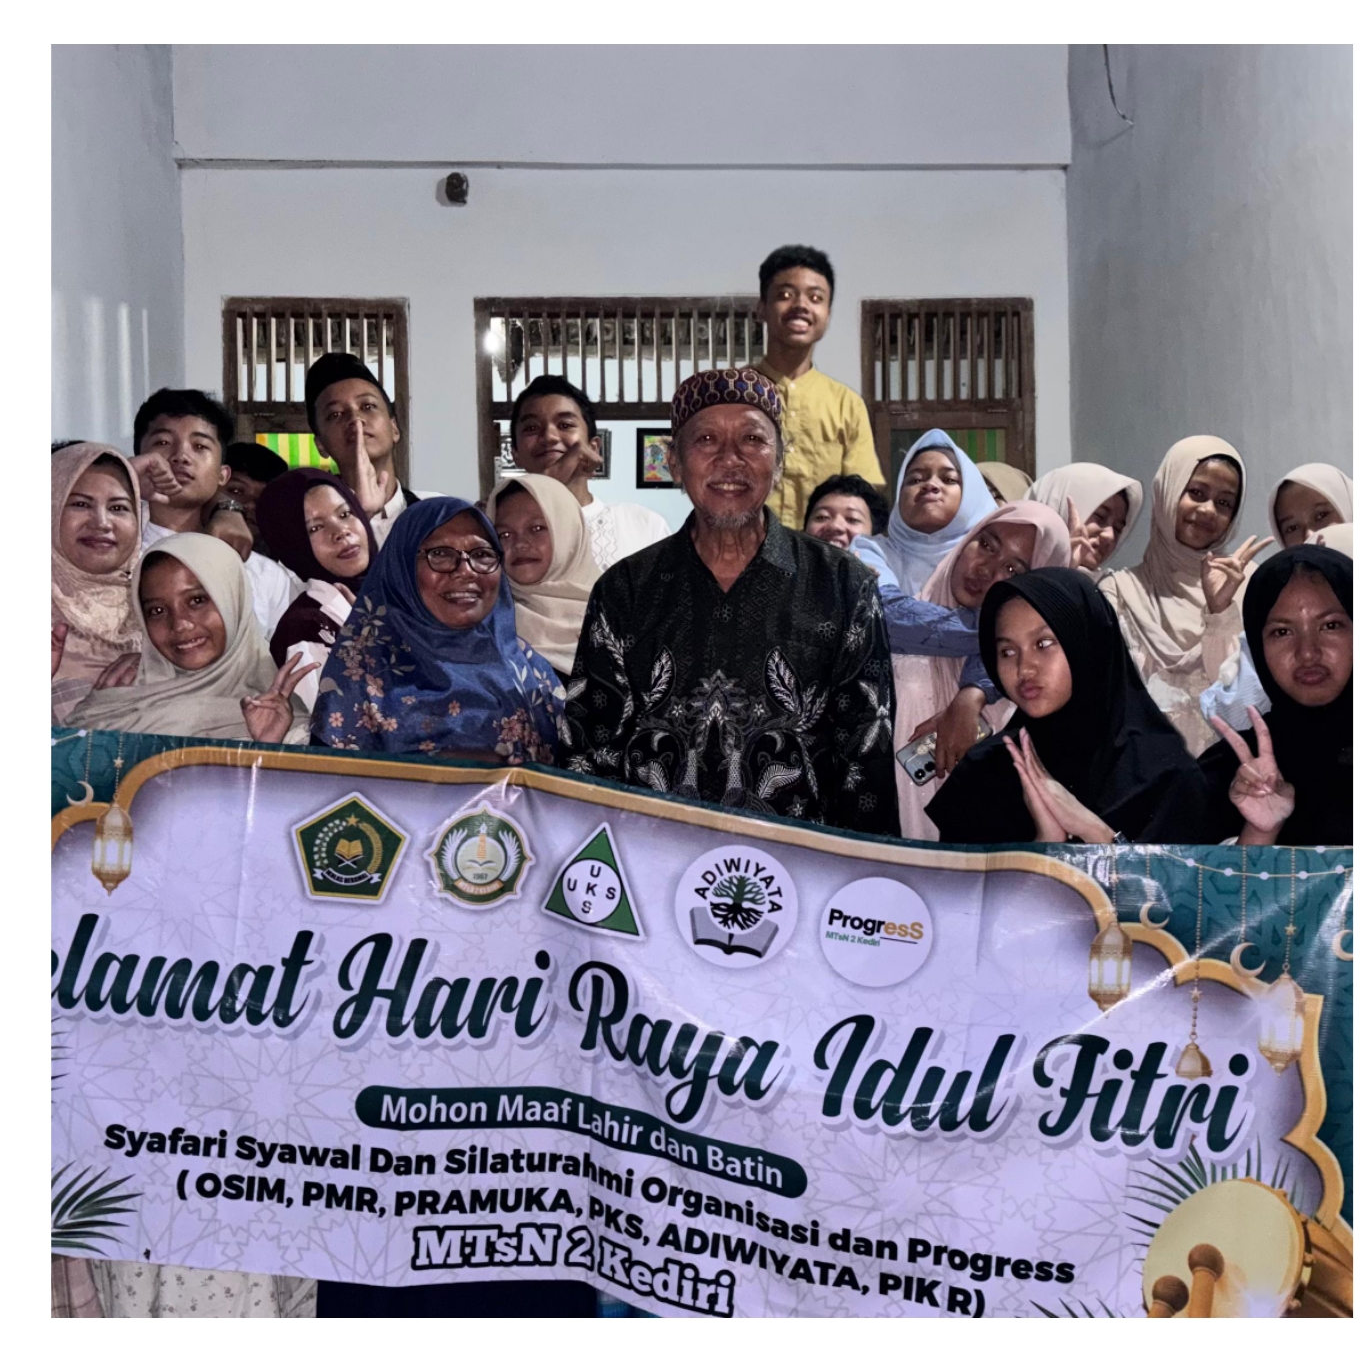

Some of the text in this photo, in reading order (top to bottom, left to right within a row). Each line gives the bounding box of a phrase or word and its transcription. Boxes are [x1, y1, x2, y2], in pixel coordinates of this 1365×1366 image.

[694, 857, 783, 914] ADIWIYATA
[827, 907, 924, 940] ProgresS
[825, 930, 850, 943] MTsN
[856, 935, 881, 948] Kediri
[332, 931, 551, 1040] Hari
[568, 959, 785, 1124] Raya
[811, 1014, 1016, 1132] Idul
[1032, 1033, 1250, 1154] Fitri
[379, 1094, 785, 1189] Mohon Maaf Lahir dan Batin
[103, 1124, 1075, 1285] Syafari Syawal Dan Silaturahmi Organisasi dan Progress
[302, 1181, 387, 1218] PMR,
[394, 1187, 584, 1219] PRAMUKA,
[588, 1200, 650, 1248] PKS,
[656, 1221, 870, 1295] ADIWIYATA,
[878, 1271, 942, 1308] PIK
[946, 1285, 986, 1318] R)
[411, 1222, 736, 1318] MTsN 2 Kediri
